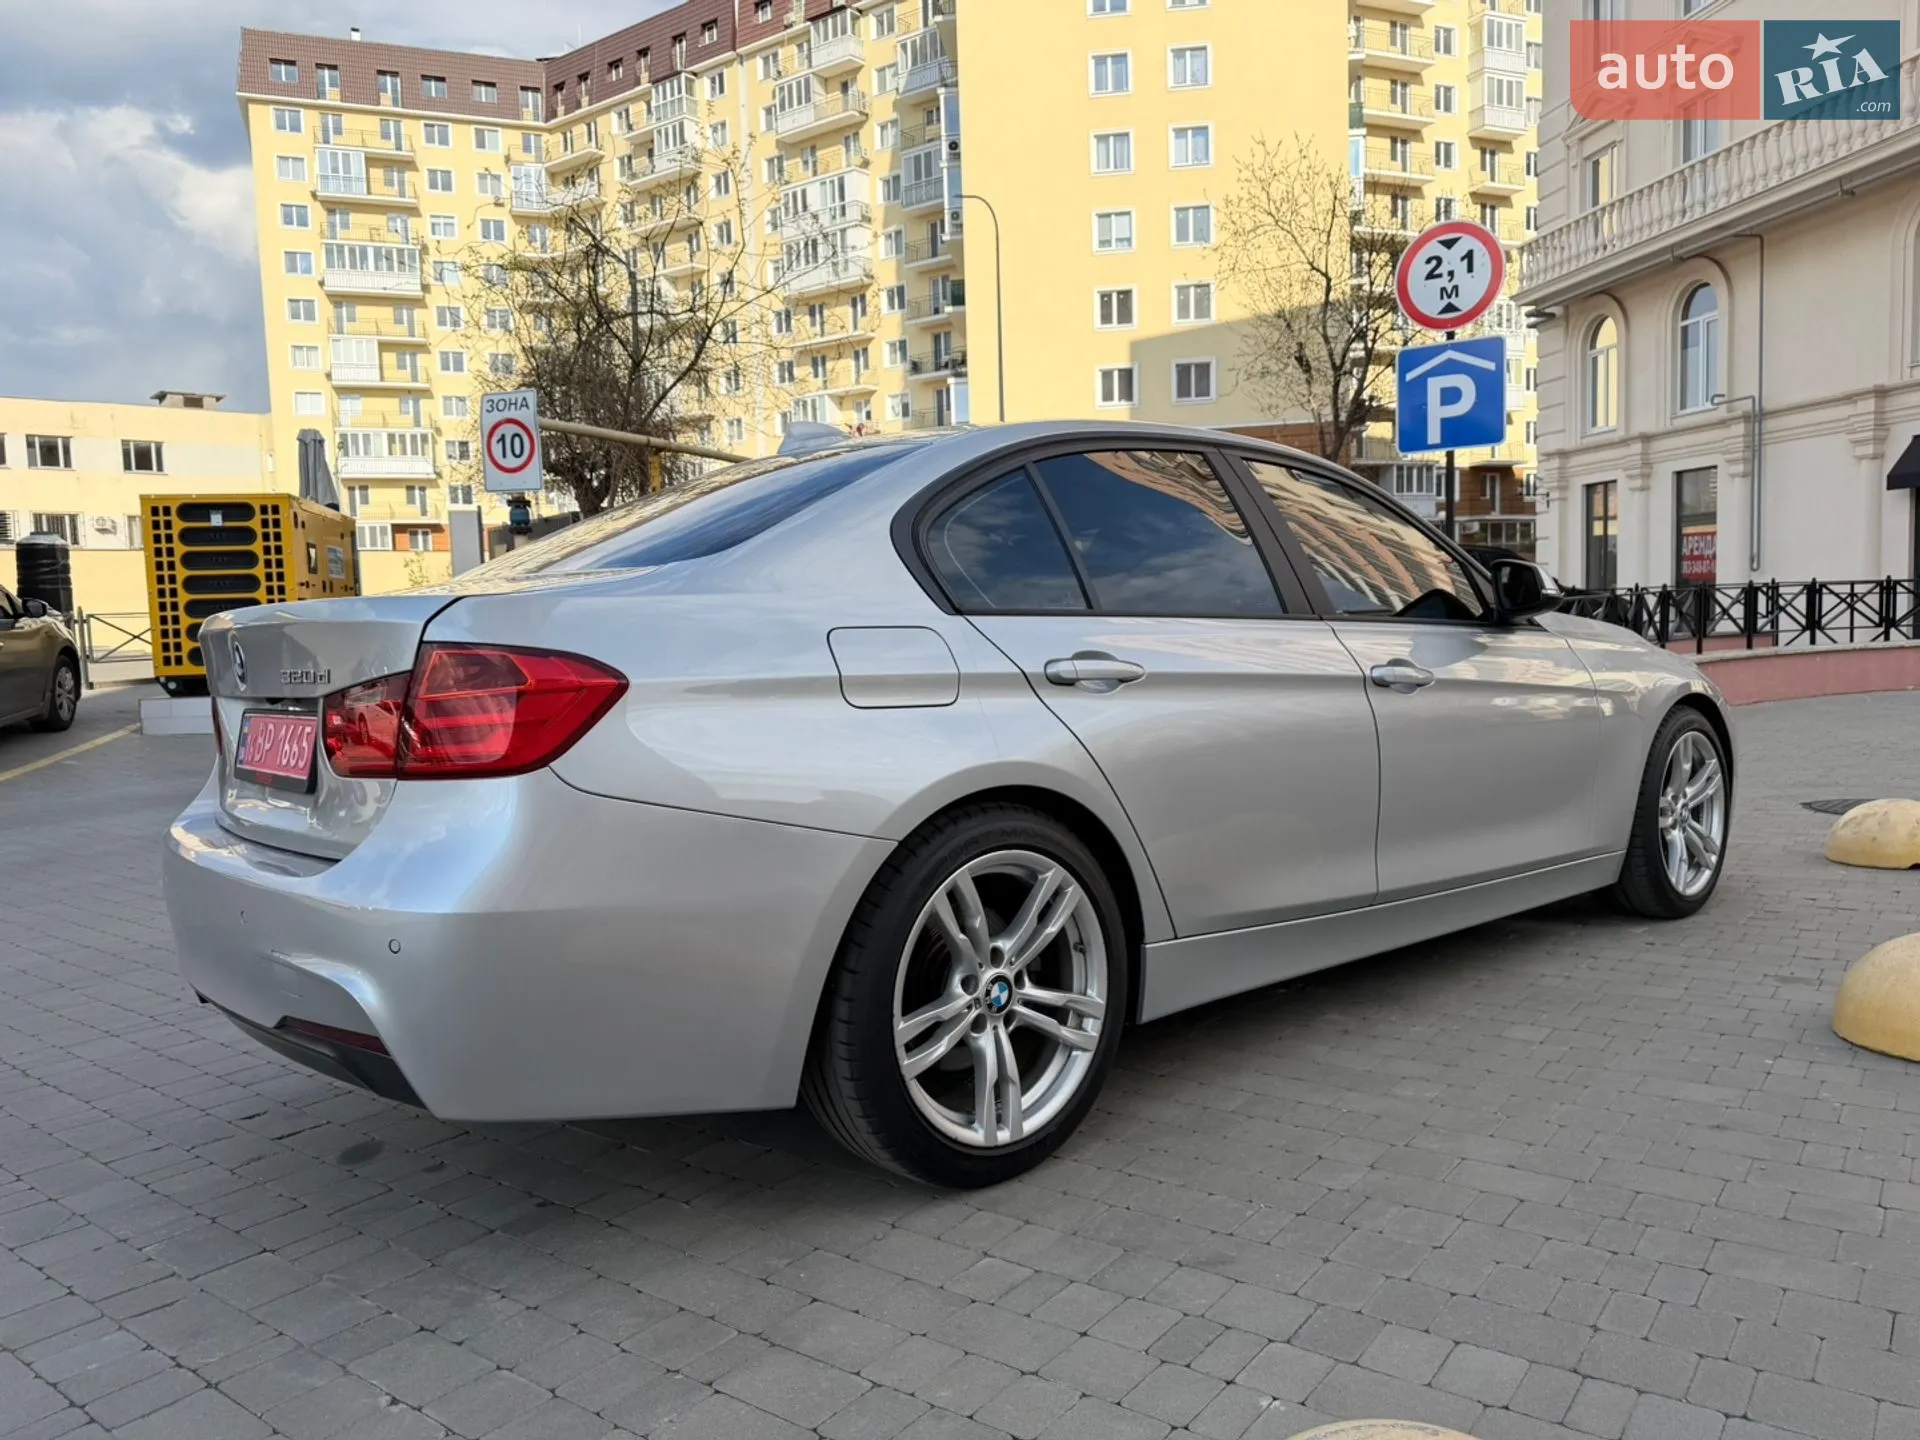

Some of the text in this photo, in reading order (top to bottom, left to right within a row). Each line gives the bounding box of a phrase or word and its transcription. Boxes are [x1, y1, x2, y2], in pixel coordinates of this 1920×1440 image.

[1424, 249, 1475, 283] 2,1
[485, 396, 530, 414] ЗОНА
[1427, 373, 1476, 445] P
[496, 432, 524, 459] 10
[277, 724, 312, 769] 1665
